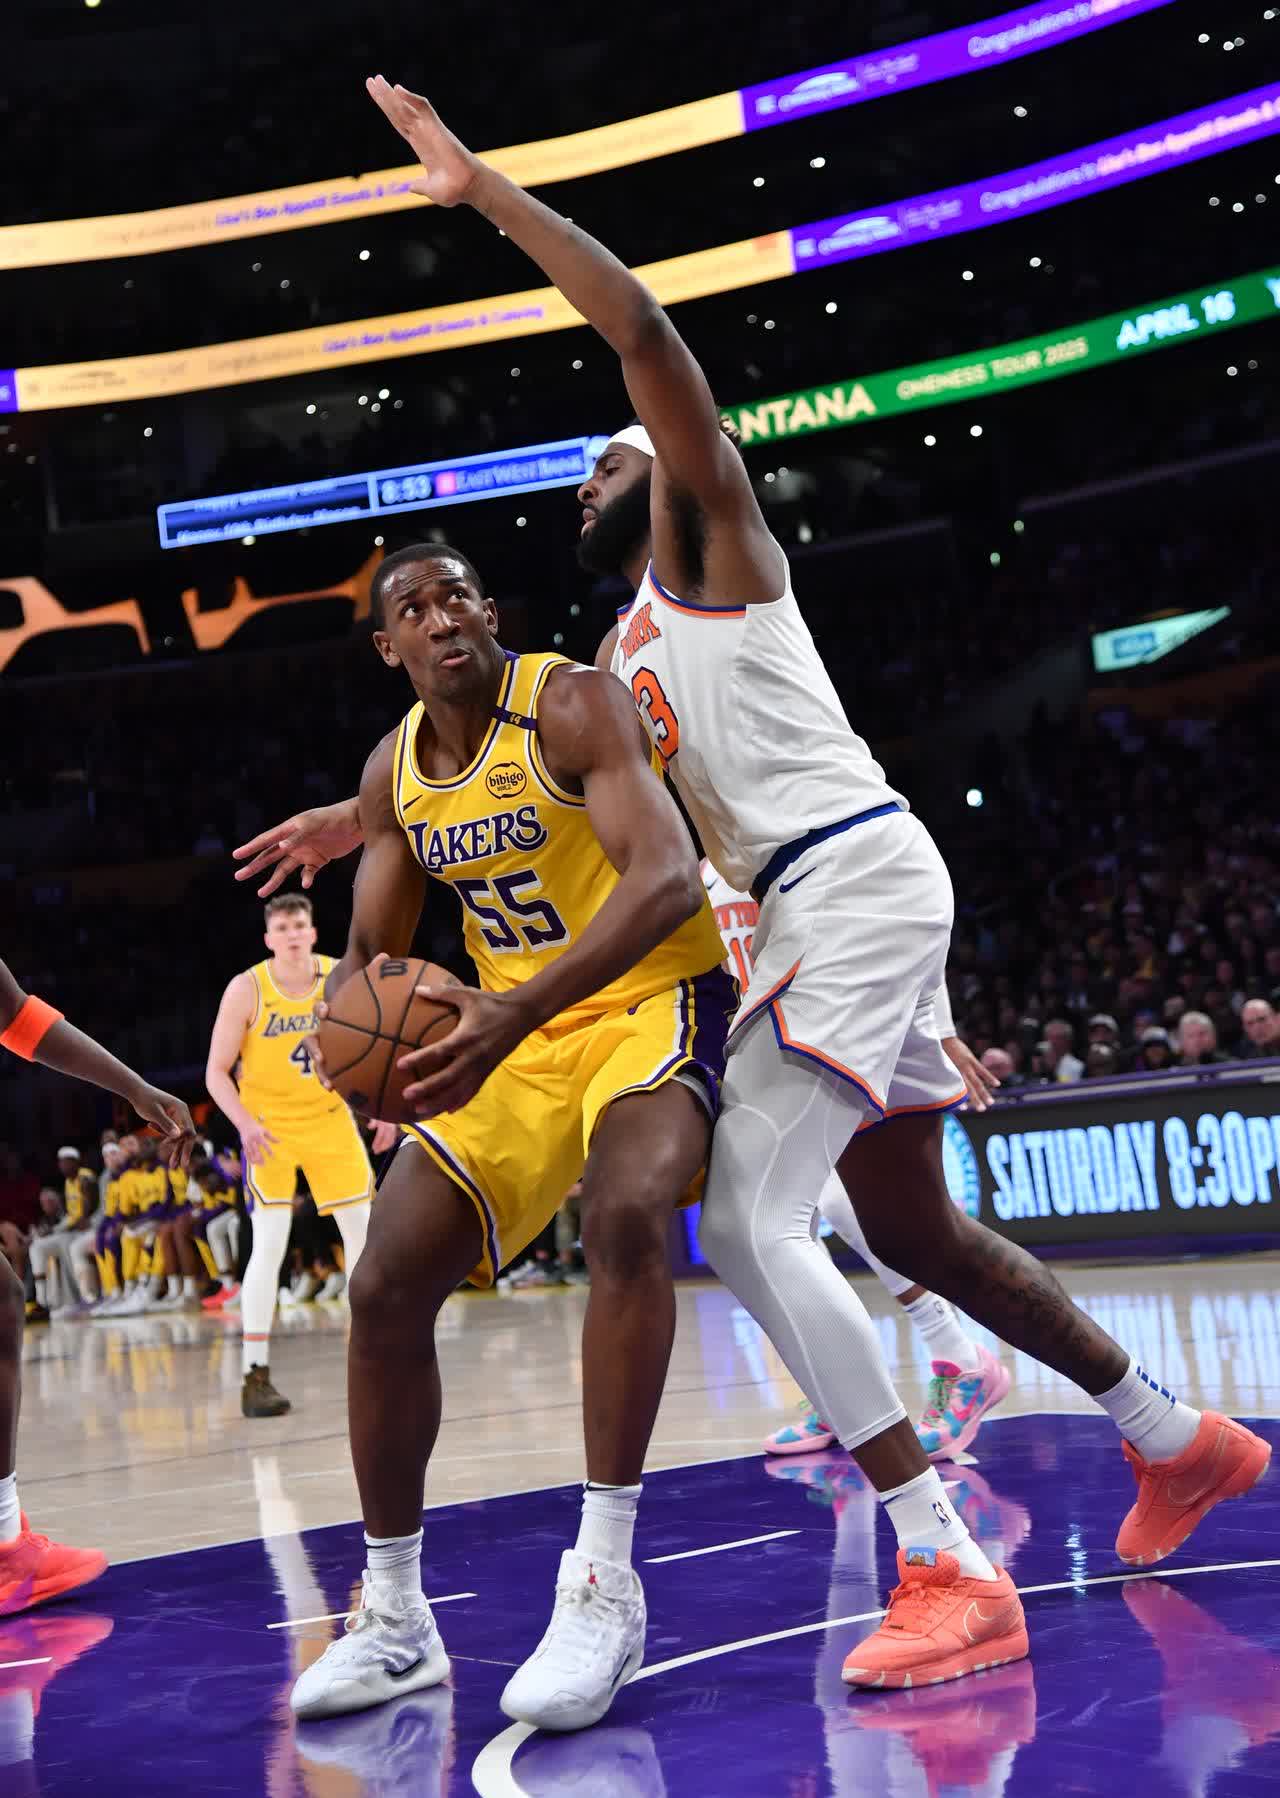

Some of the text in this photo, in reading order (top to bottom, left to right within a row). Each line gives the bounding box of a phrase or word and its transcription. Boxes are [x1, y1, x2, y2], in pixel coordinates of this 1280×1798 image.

[721, 383, 877, 442] ANTANA
[992, 349, 1042, 379] TOUR
[1116, 303, 1200, 350] APRIL
[1201, 291, 1236, 325] 16
[631, 665, 679, 761] 3
[488, 771, 524, 789] bibigo
[407, 804, 549, 875] LAKERS
[452, 868, 571, 955] 55
[262, 1013, 320, 1038] LAKER
[985, 1120, 1161, 1221] SATURDAY
